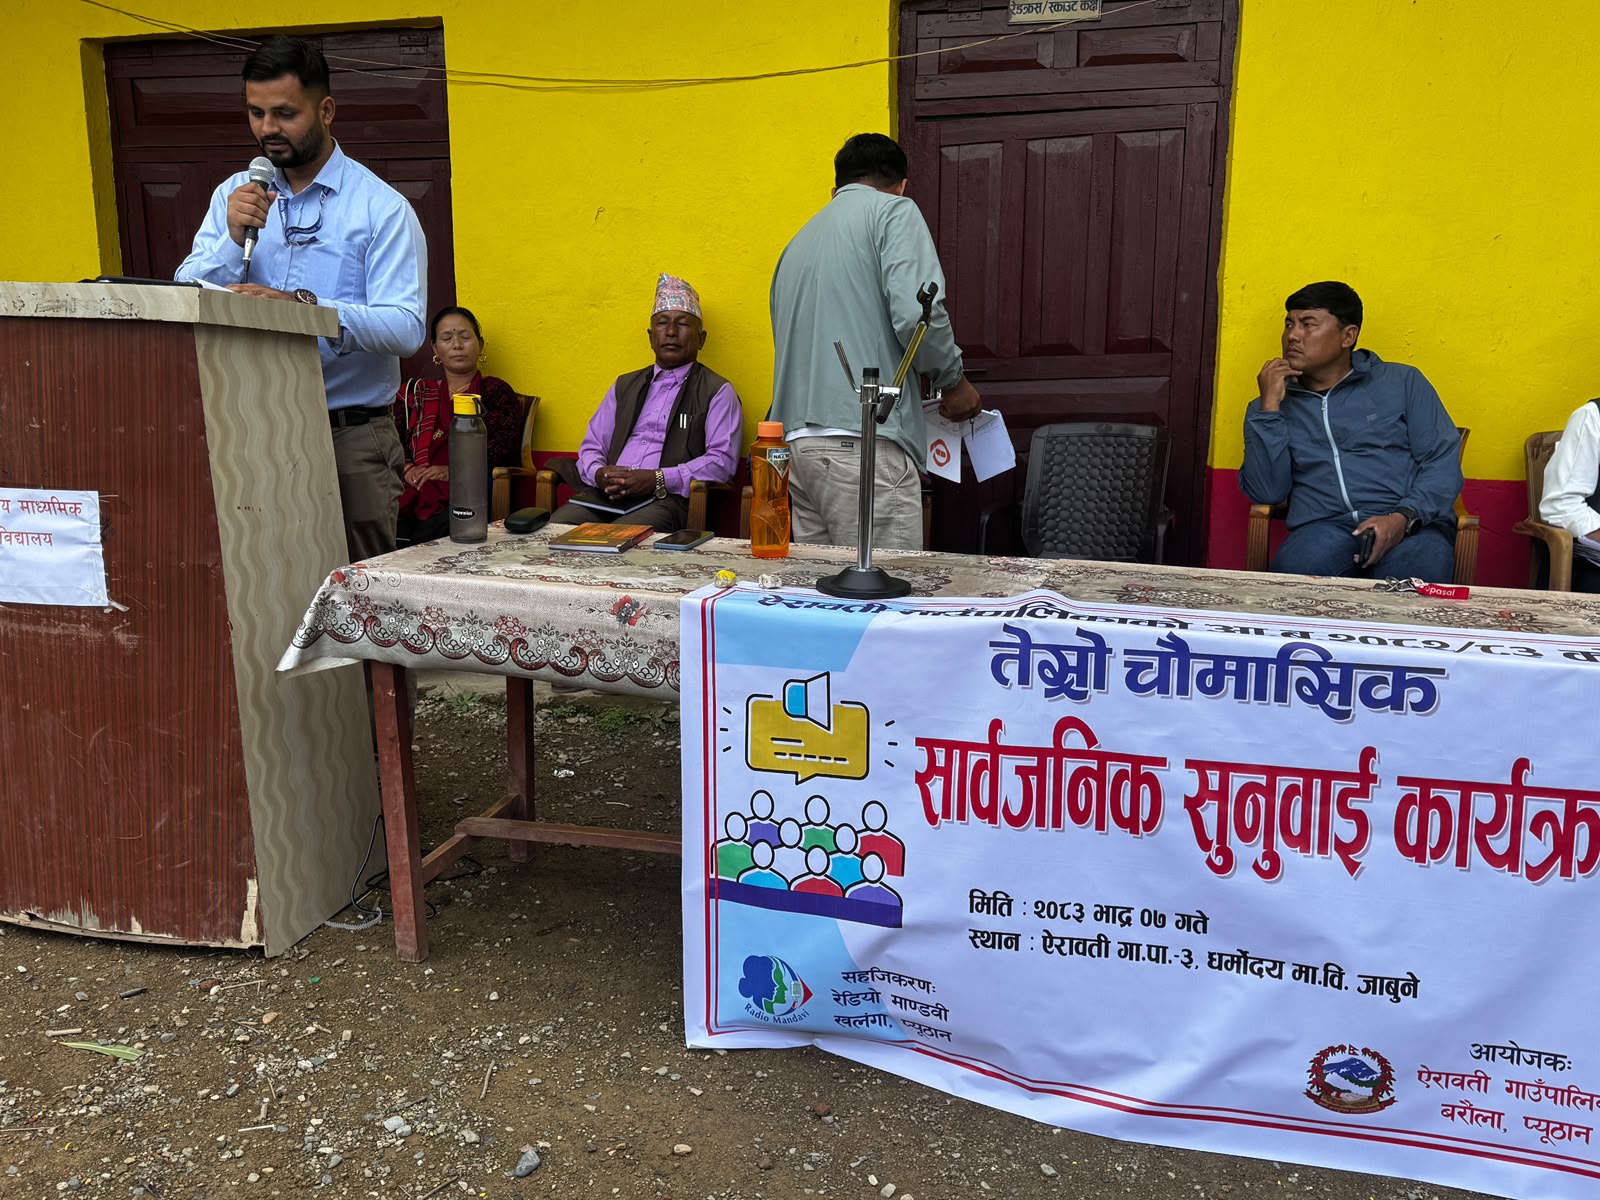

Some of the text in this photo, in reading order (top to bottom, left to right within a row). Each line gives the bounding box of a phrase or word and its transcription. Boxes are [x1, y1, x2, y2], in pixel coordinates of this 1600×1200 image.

[18, 496, 82, 516] माध्यमिक
[0, 526, 53, 546] विद्यालय
[989, 623, 1447, 721] तेस्रो चौमासिक
[914, 715, 1168, 836] सार्वजनिक
[1183, 745, 1378, 881] सुनुवाई
[968, 888, 1014, 917] मिति
[1033, 899, 1085, 924] २०८३
[1093, 903, 1135, 928] भाद्र
[1139, 908, 1167, 929] ०७
[1174, 910, 1210, 935] गते
[968, 928, 1022, 952] स्थान
[1041, 929, 1112, 959] ऐरावती
[1207, 949, 1286, 980] धर्मोदय
[1291, 962, 1349, 991] मा.वि.
[1356, 972, 1421, 1004] जाबुने
[744, 1002, 810, 1024] Radio Mandavi
[830, 987, 950, 1023] रेडियो माण्डवी
[901, 1018, 953, 1043] प्यूठान
[1417, 1064, 1600, 1112] ऐरावती गाउँपालि
[1522, 1115, 1594, 1147] प्यूठान
